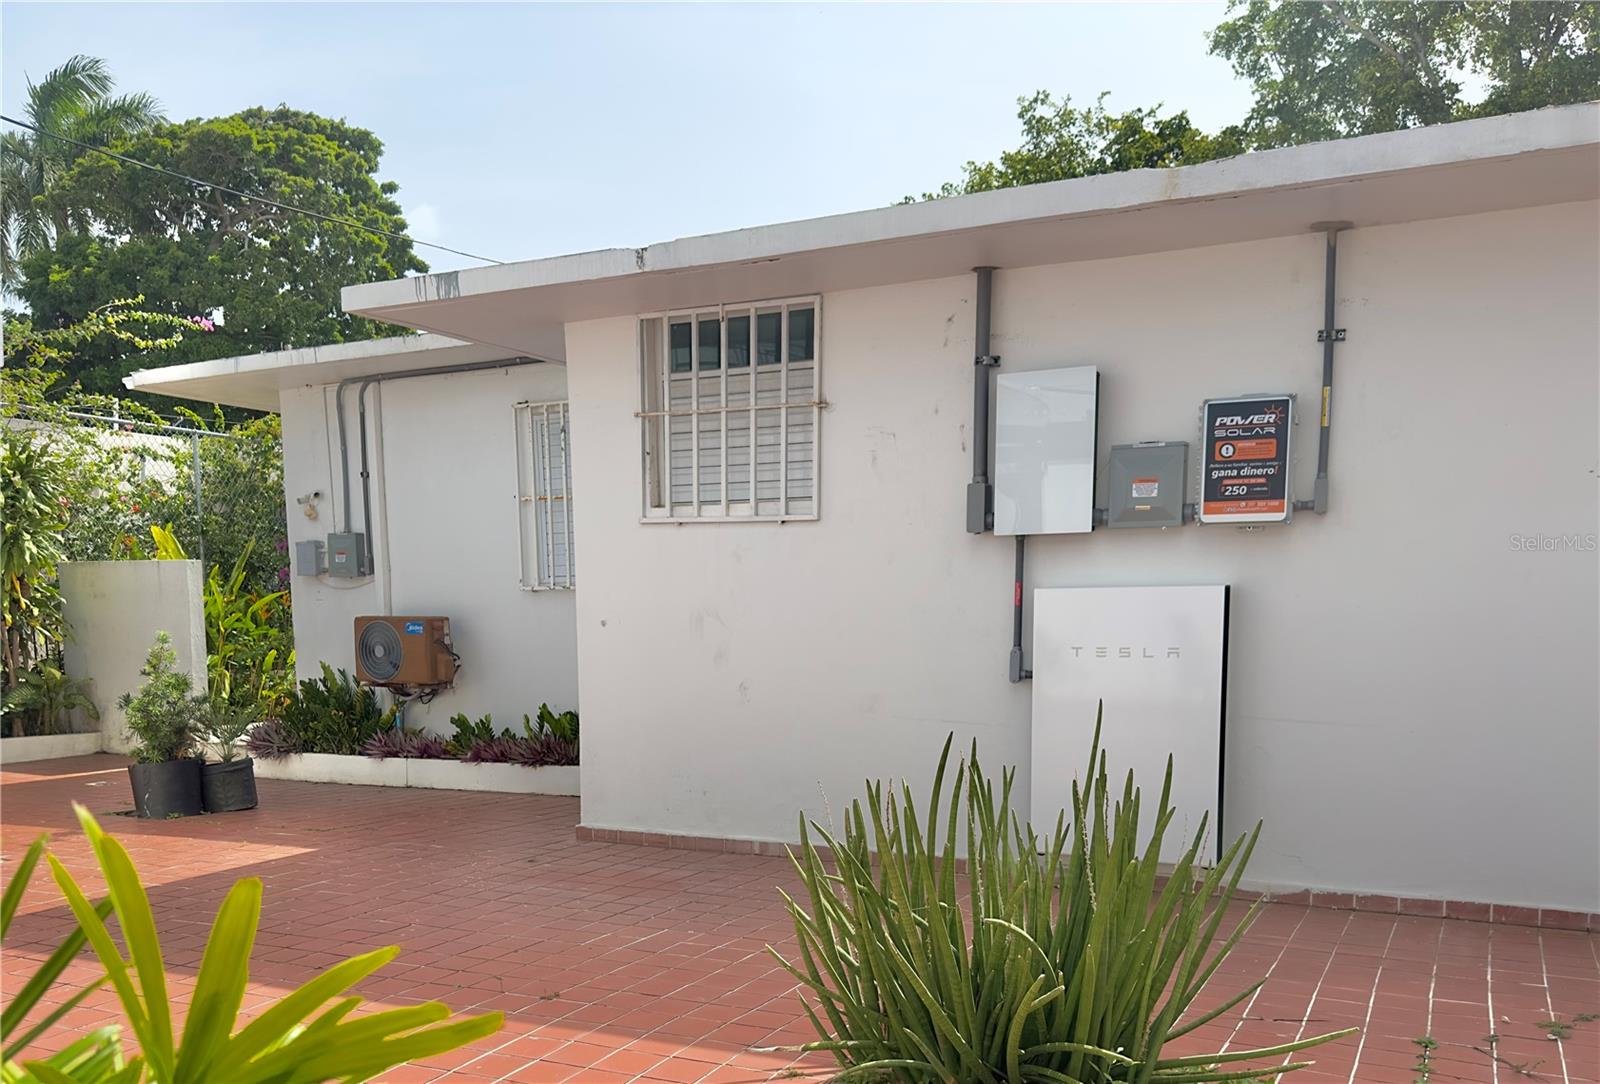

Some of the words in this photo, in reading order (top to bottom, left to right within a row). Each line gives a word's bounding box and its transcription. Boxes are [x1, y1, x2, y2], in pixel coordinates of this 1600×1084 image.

[1215, 414, 1276, 426] POWER
[1214, 427, 1276, 437] SOLAR
[1211, 469, 1238, 479] gana
[1240, 465, 1278, 476] dinero!
[1071, 646, 1181, 659] TESLA
